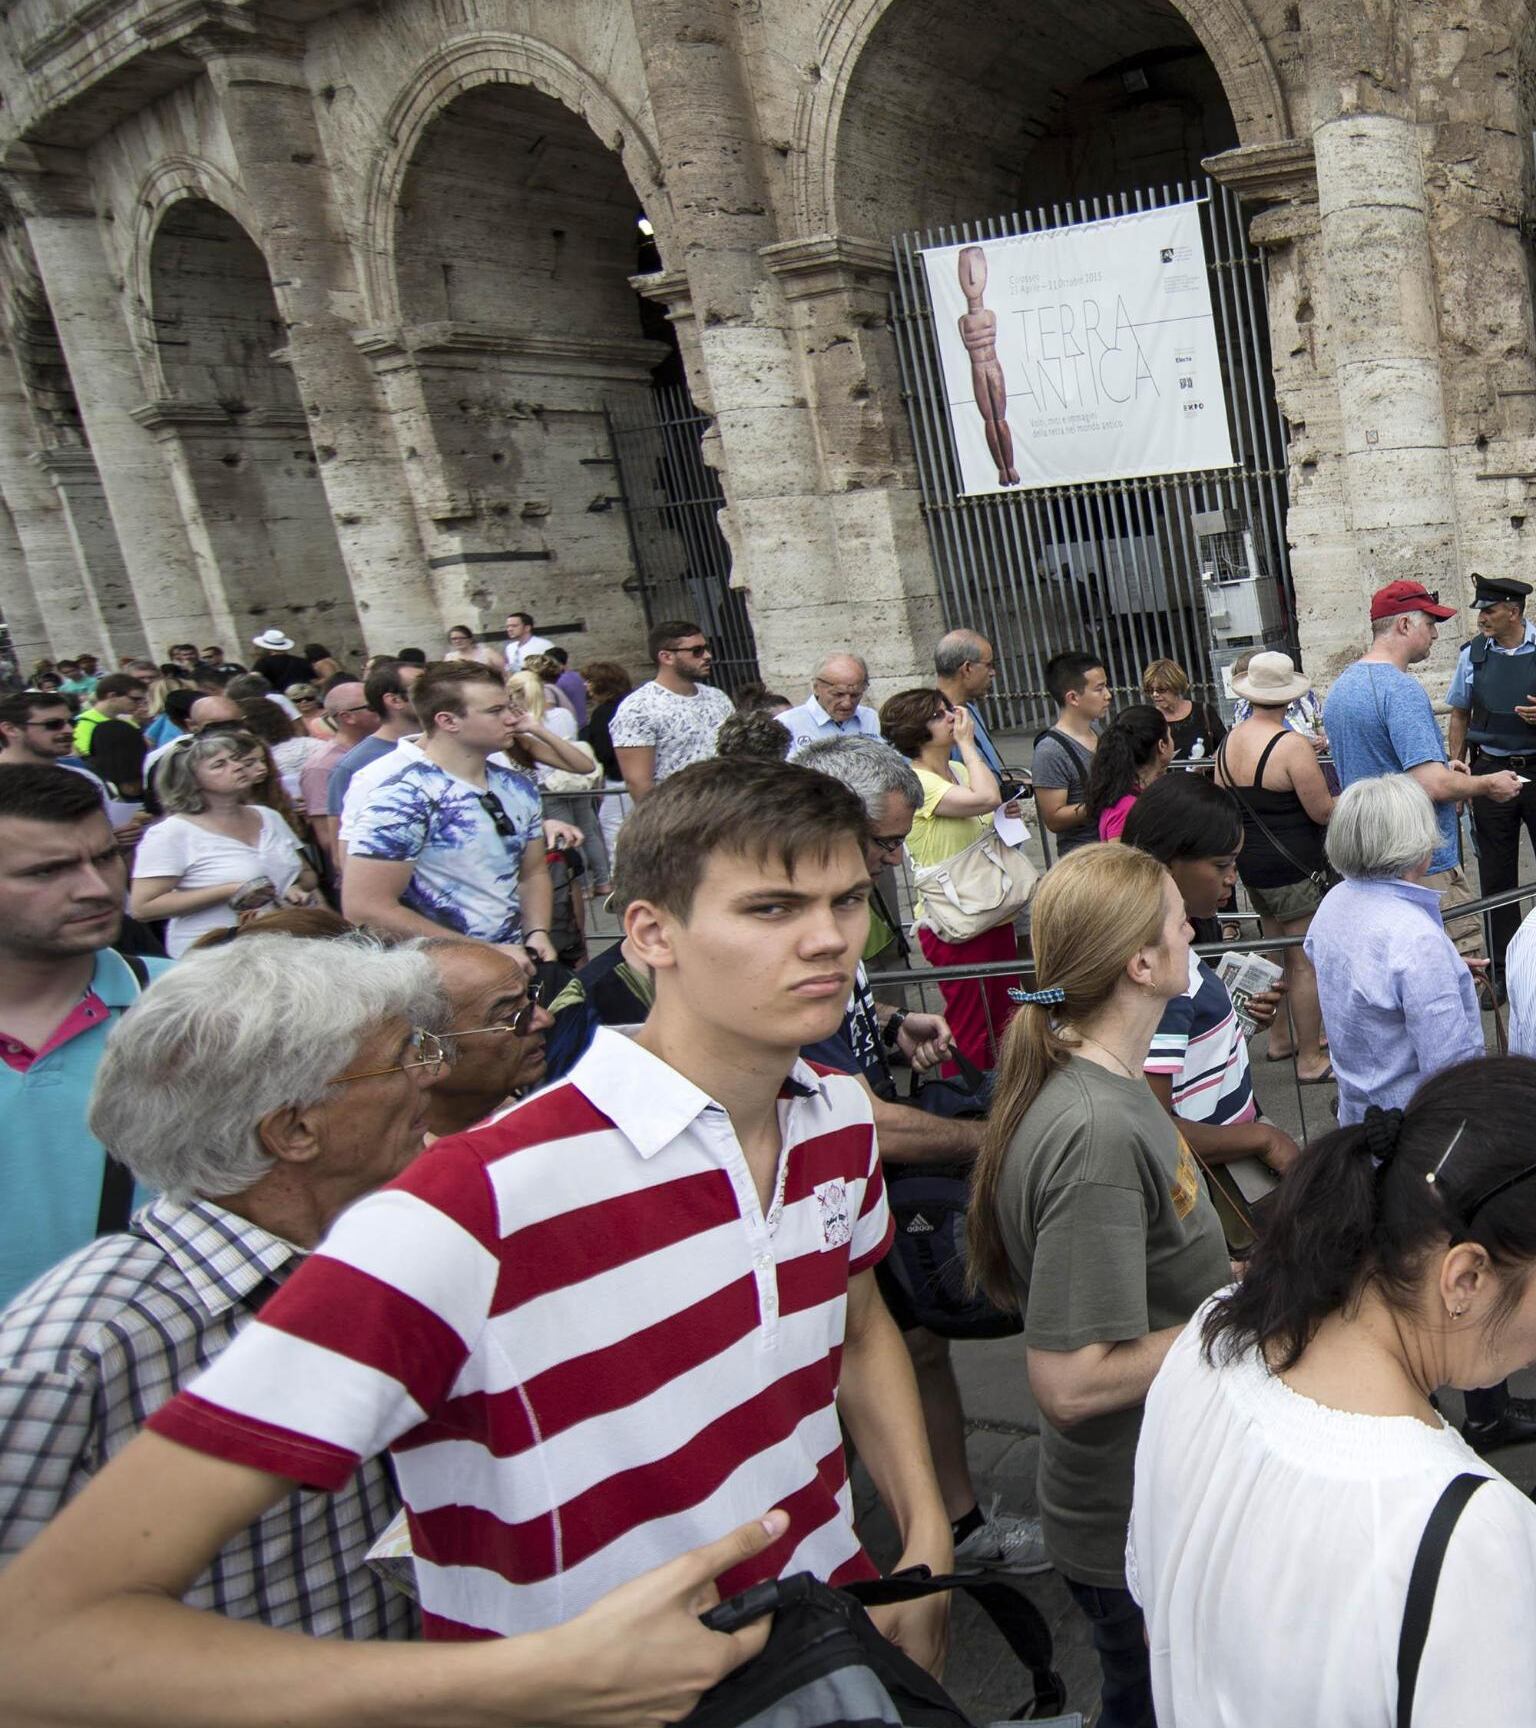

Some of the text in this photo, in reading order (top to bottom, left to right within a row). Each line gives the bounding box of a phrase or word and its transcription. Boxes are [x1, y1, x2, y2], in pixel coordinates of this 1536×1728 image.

[1011, 294, 1140, 361] TERRA
[1183, 403, 1204, 412] EXPO
[906, 1223, 934, 1233] adidas
